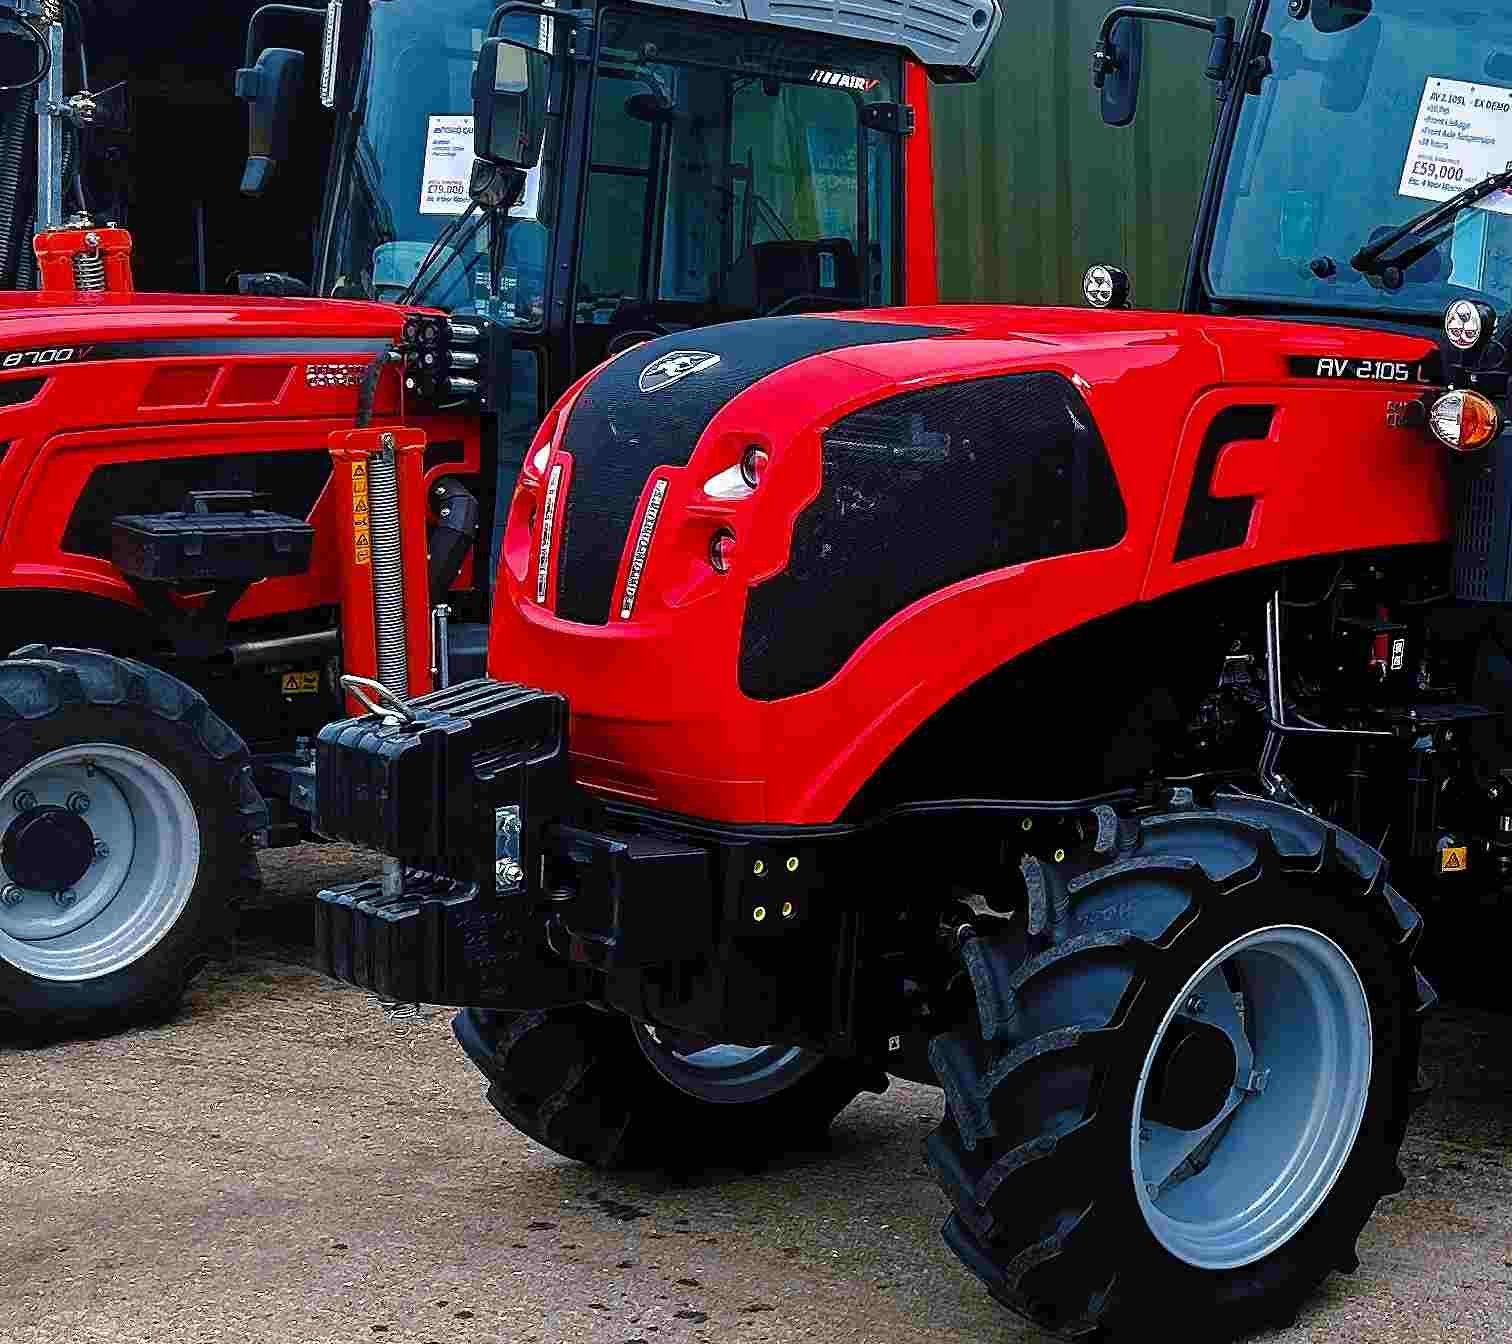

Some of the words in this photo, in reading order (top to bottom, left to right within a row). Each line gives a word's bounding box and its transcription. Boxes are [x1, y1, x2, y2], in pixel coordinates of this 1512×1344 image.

[1412, 161, 1464, 182] £59,000
[3, 348, 74, 367] 8700
[1316, 358, 1349, 377] AV
[1356, 360, 1409, 381] 2.105
[1417, 364, 1431, 383] L
